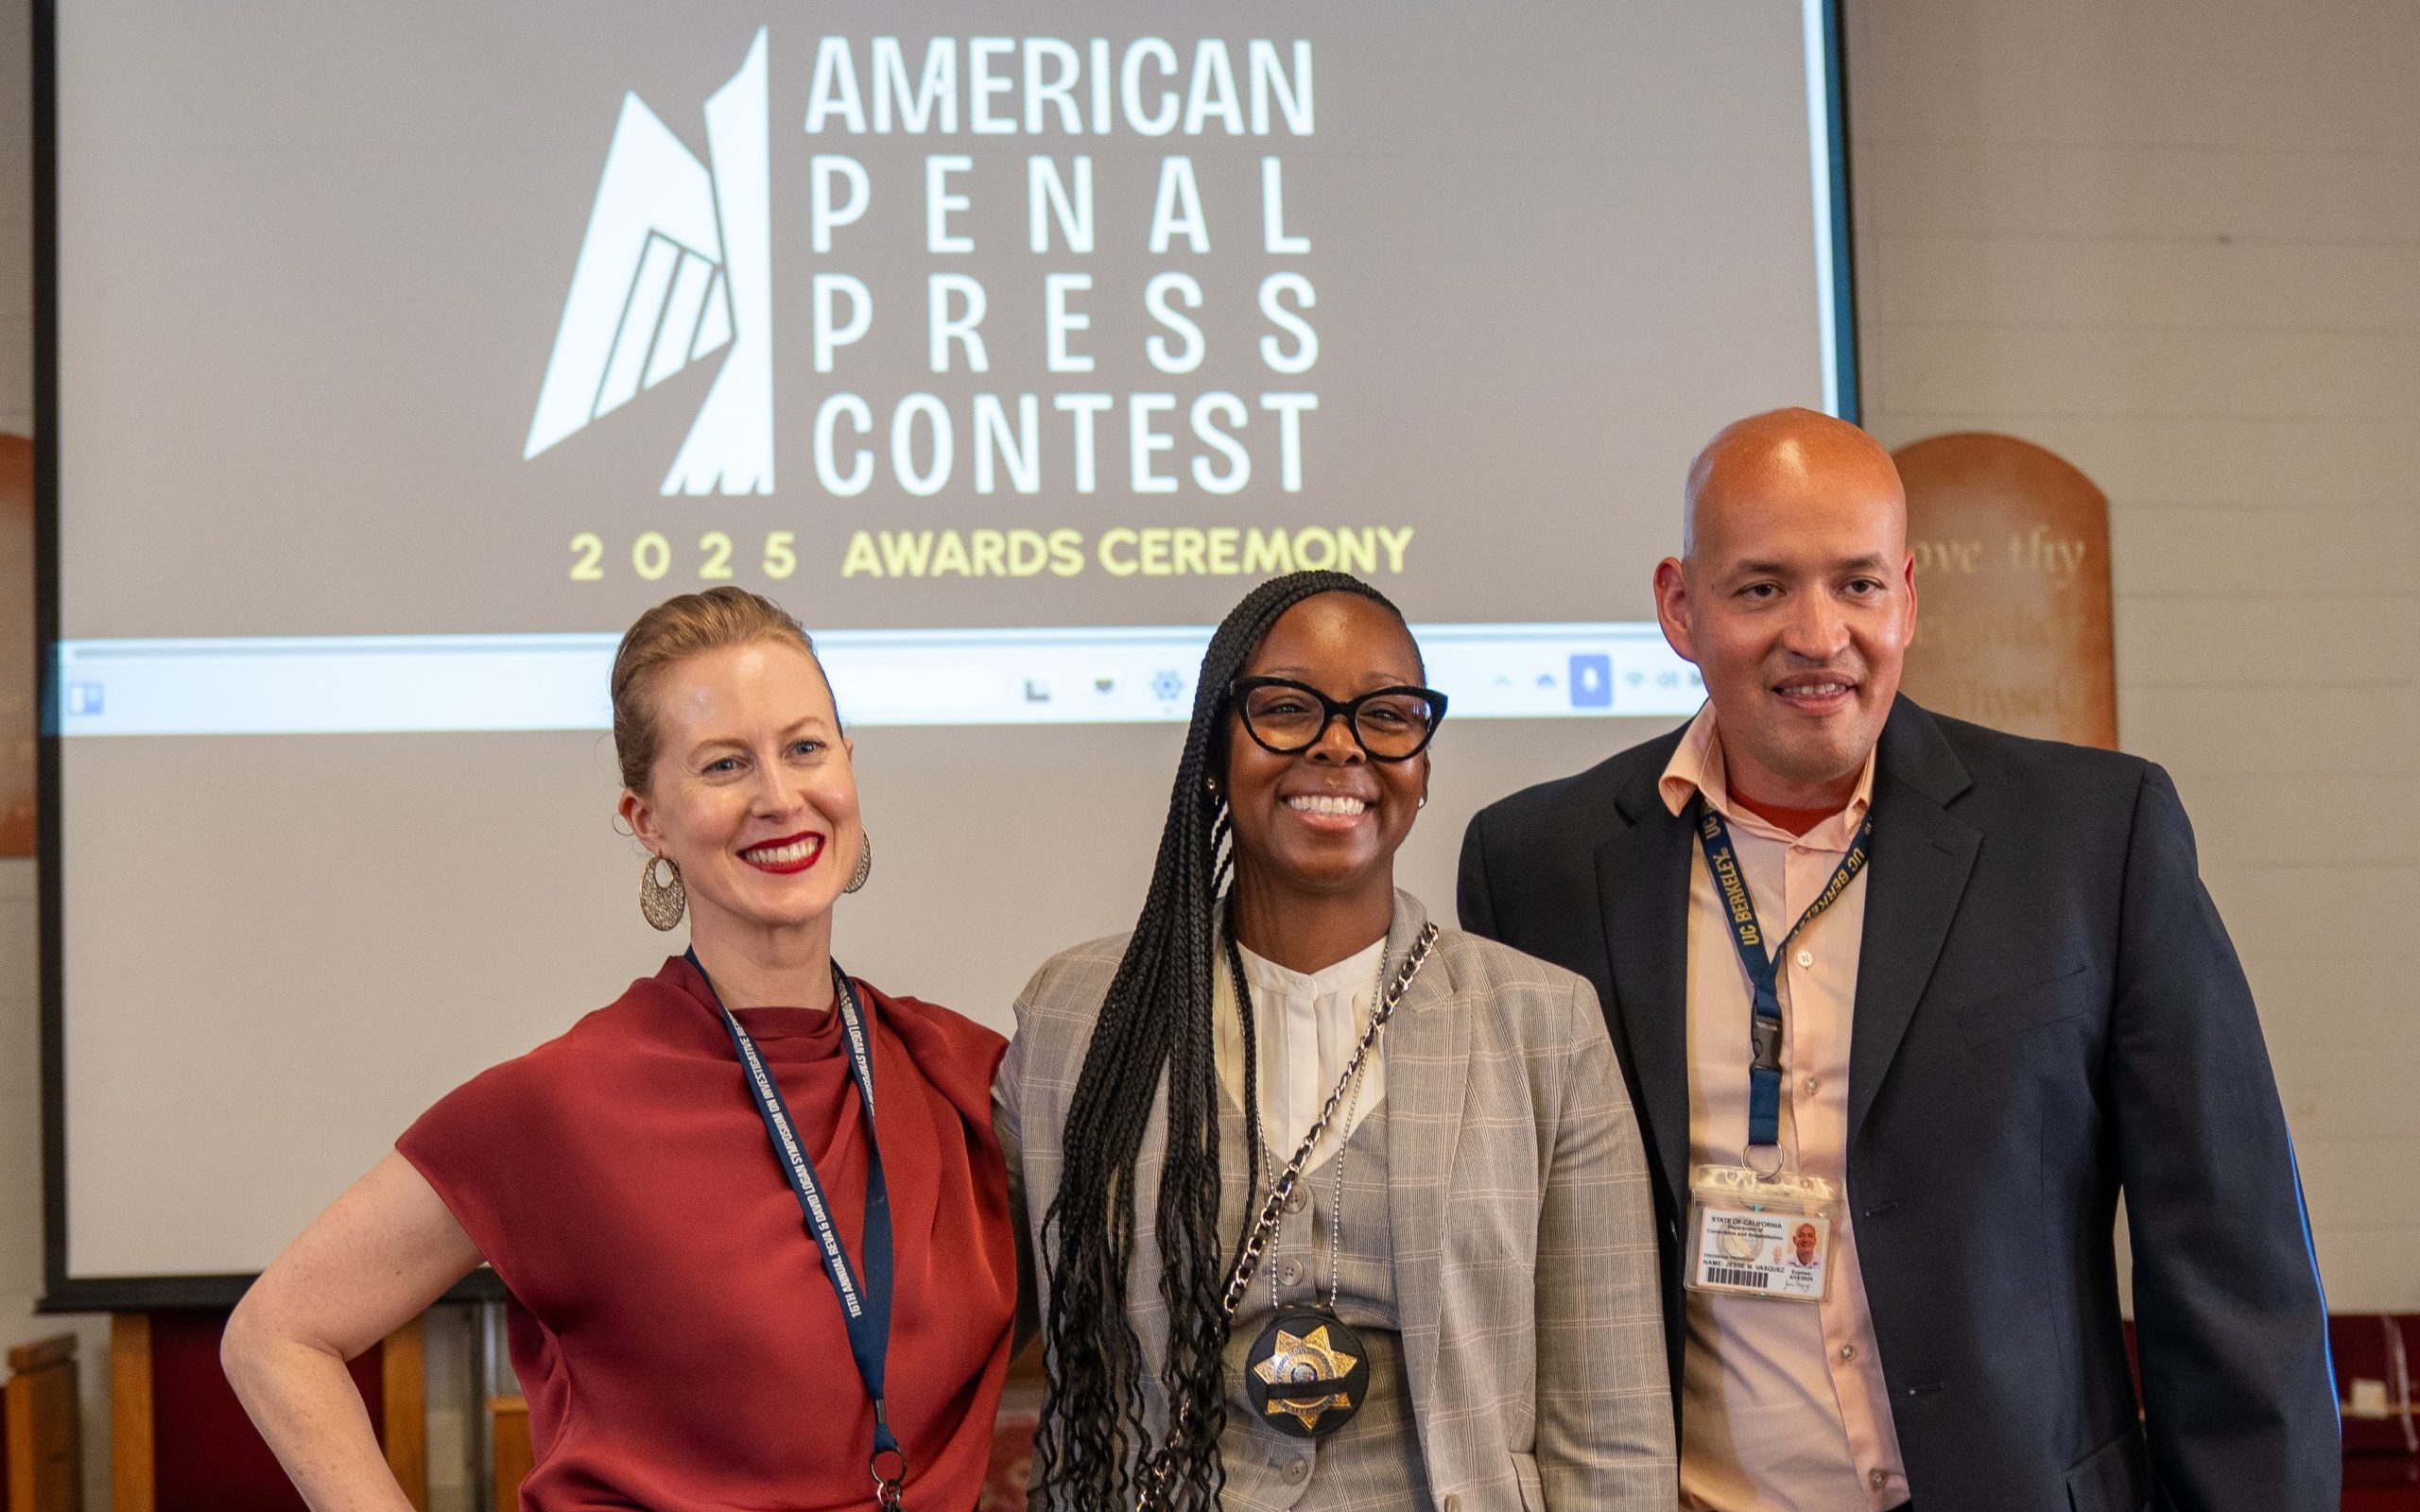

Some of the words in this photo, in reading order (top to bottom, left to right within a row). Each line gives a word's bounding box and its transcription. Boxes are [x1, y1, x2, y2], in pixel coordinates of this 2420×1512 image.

[804, 36, 1315, 137] AMERICAN
[810, 154, 1312, 254] PENAL
[812, 271, 1320, 374] PRESS
[813, 391, 1319, 497] CONTEST
[840, 527, 1085, 578] AWARDS
[1097, 524, 1415, 576] CEREMONY
[1914, 541, 1981, 575] ove
[2011, 524, 2086, 590] thy
[1847, 847, 1865, 871] UC
[1713, 852, 1753, 923] BERKELEY
[1739, 923, 1759, 946] UC
[848, 1025, 866, 1055] LOGAN
[740, 1037, 773, 1100] INVESTIGATIVE
[766, 1097, 780, 1113] ON
[771, 1111, 804, 1166] SYMPOSIUM
[795, 1163, 814, 1194] LOGAN
[807, 1193, 826, 1223] DAVID
[1742, 1219, 1782, 1228] CALIFORNIA
[821, 1230, 838, 1256] REVA
[832, 1256, 853, 1294] ANNUAL
[1754, 1264, 1785, 1273] VASQUEZ
[844, 1293, 862, 1318] 16TH
